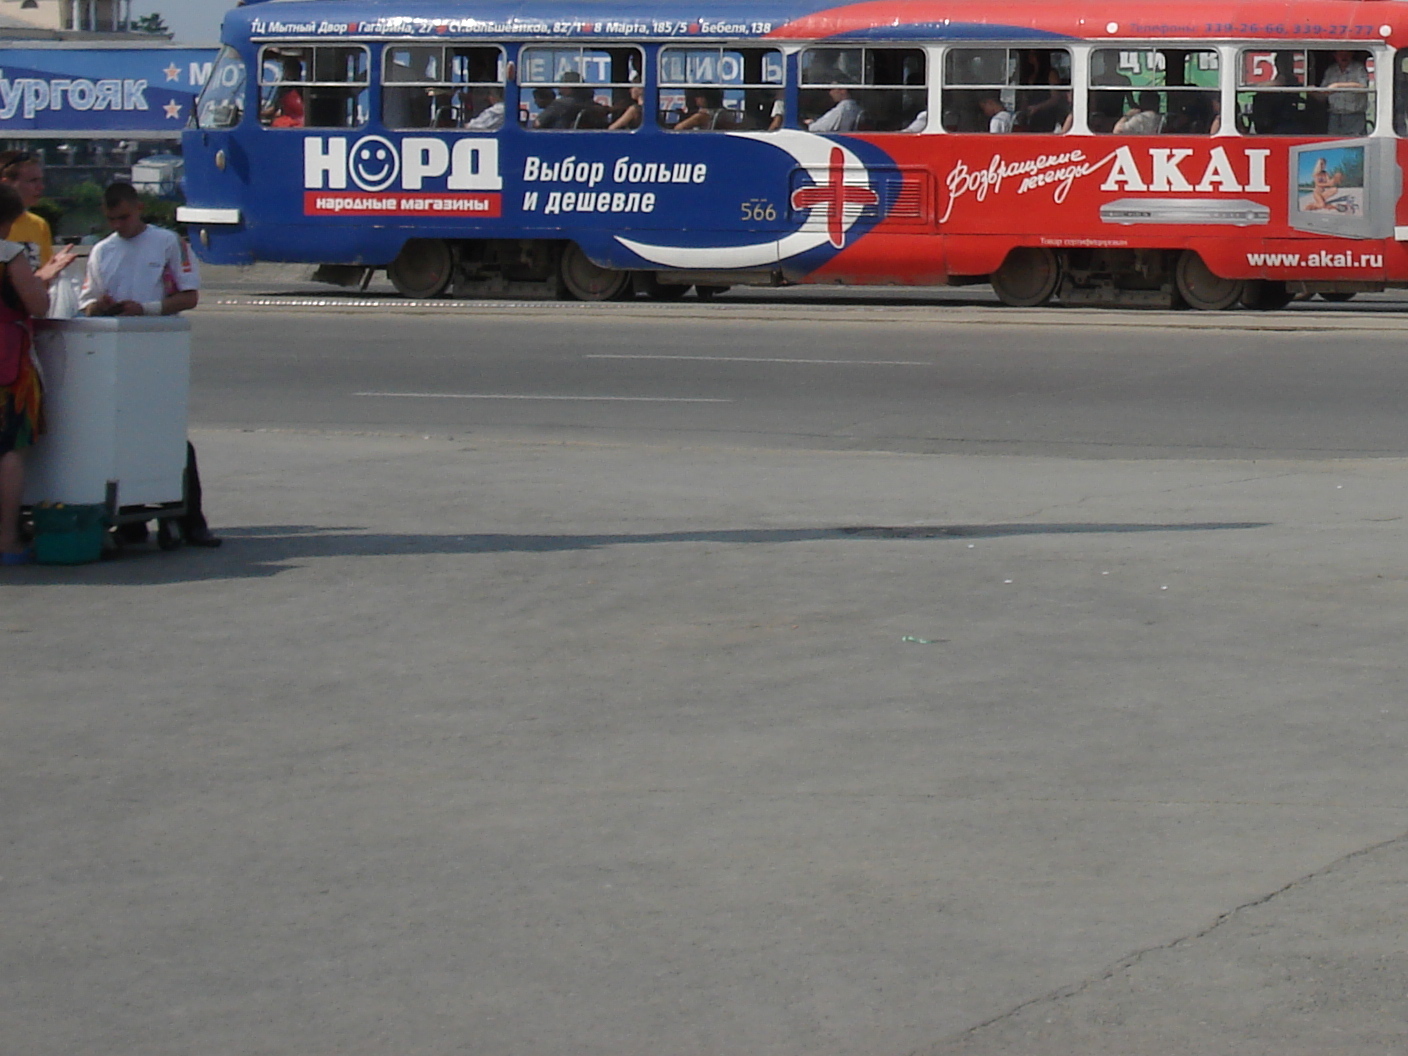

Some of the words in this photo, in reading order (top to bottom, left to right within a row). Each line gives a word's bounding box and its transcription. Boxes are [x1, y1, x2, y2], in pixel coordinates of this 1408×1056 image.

[268, 20, 315, 33] Мытный
[318, 21, 347, 34] Двор
[593, 22, 602, 33] 8
[652, 21, 688, 36] 185/5
[701, 21, 749, 34] Бебеля,
[752, 22, 771, 34] 138
[0, 78, 149, 120] ургояк
[523, 155, 606, 188] Выбор
[613, 158, 707, 184] больше
[1099, 145, 1271, 193] AKAI
[938, 148, 1087, 224] Возвращение
[315, 196, 397, 213] народные
[400, 197, 490, 212] магазины
[523, 191, 538, 212] и
[545, 189, 656, 215] дешевле
[741, 202, 776, 221] 566
[1246, 250, 1383, 269] www.akai.ru
